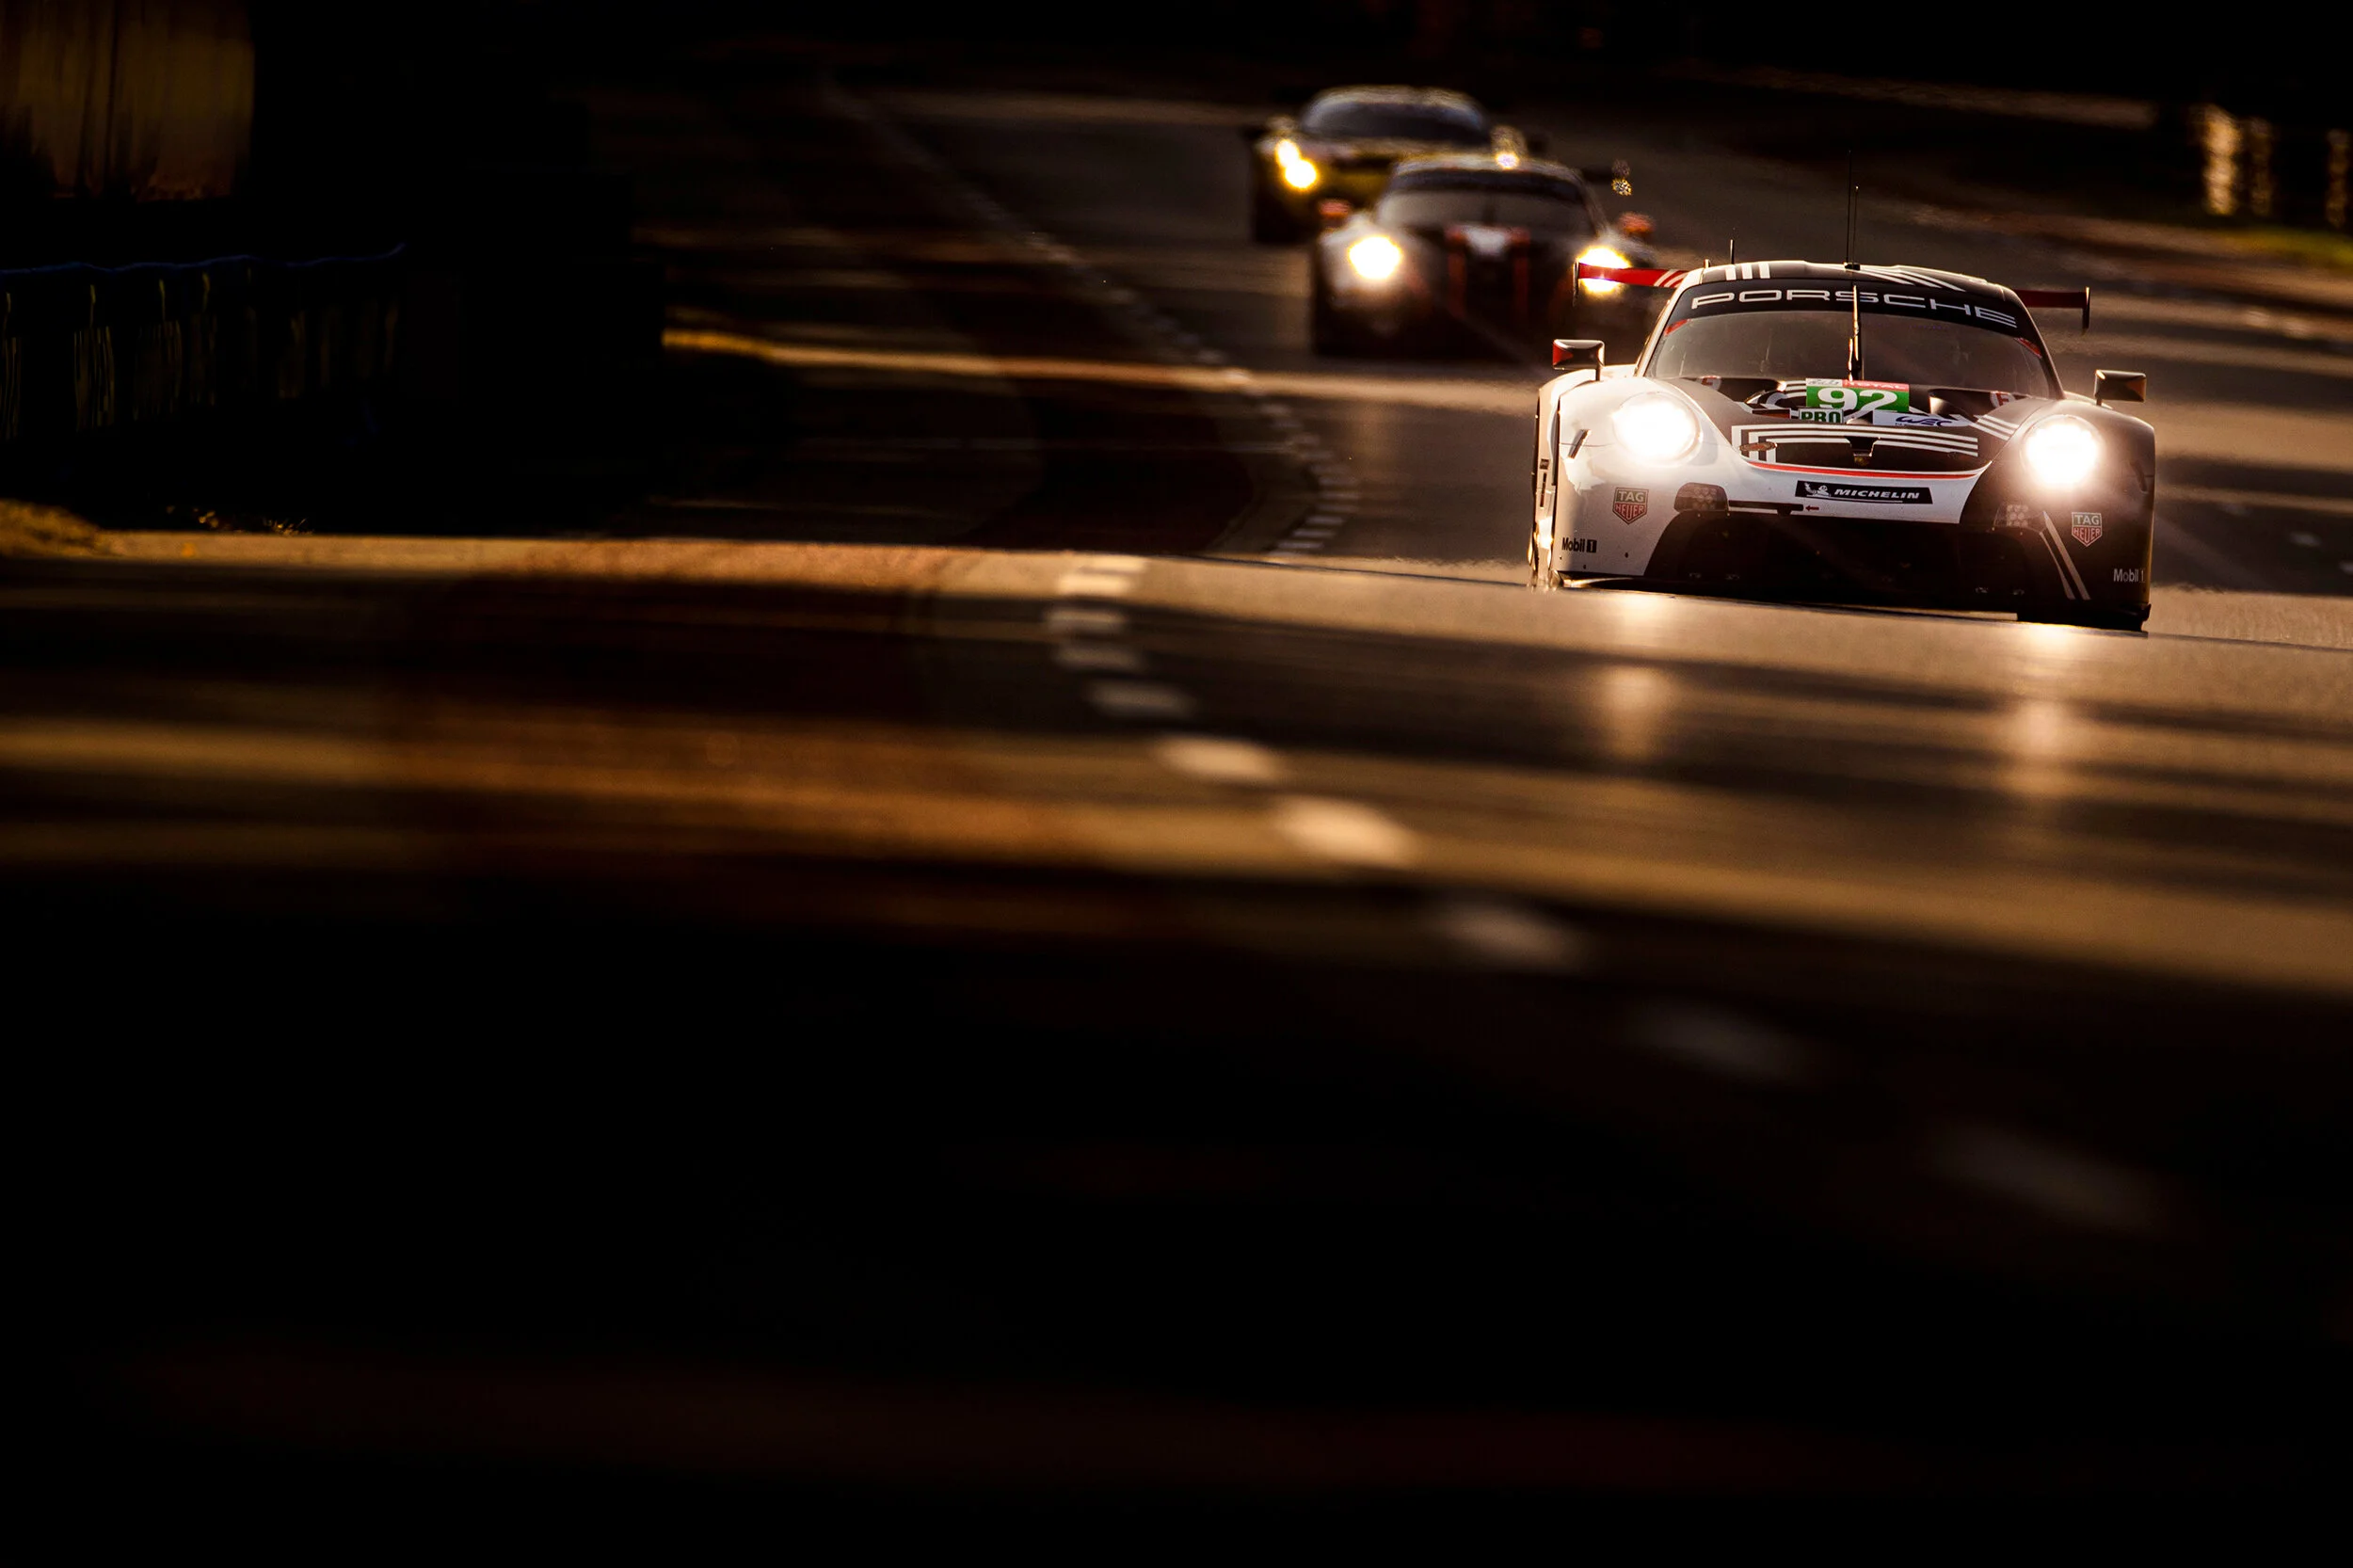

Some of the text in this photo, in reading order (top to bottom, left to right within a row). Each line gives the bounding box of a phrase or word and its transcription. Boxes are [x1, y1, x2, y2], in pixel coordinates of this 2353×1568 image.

[1691, 289, 2017, 328] PORSCHE
[1817, 388, 1897, 419] 92
[1801, 411, 1842, 424] PRO
[1619, 490, 1644, 503] TAG
[1834, 488, 1920, 499] MICHELIN
[1614, 504, 1644, 520] HEUER
[2073, 515, 2100, 525] TAG
[2073, 527, 2101, 543] HEUER
[1561, 537, 1586, 552] Mobil
[2113, 568, 2139, 583] Mobil
